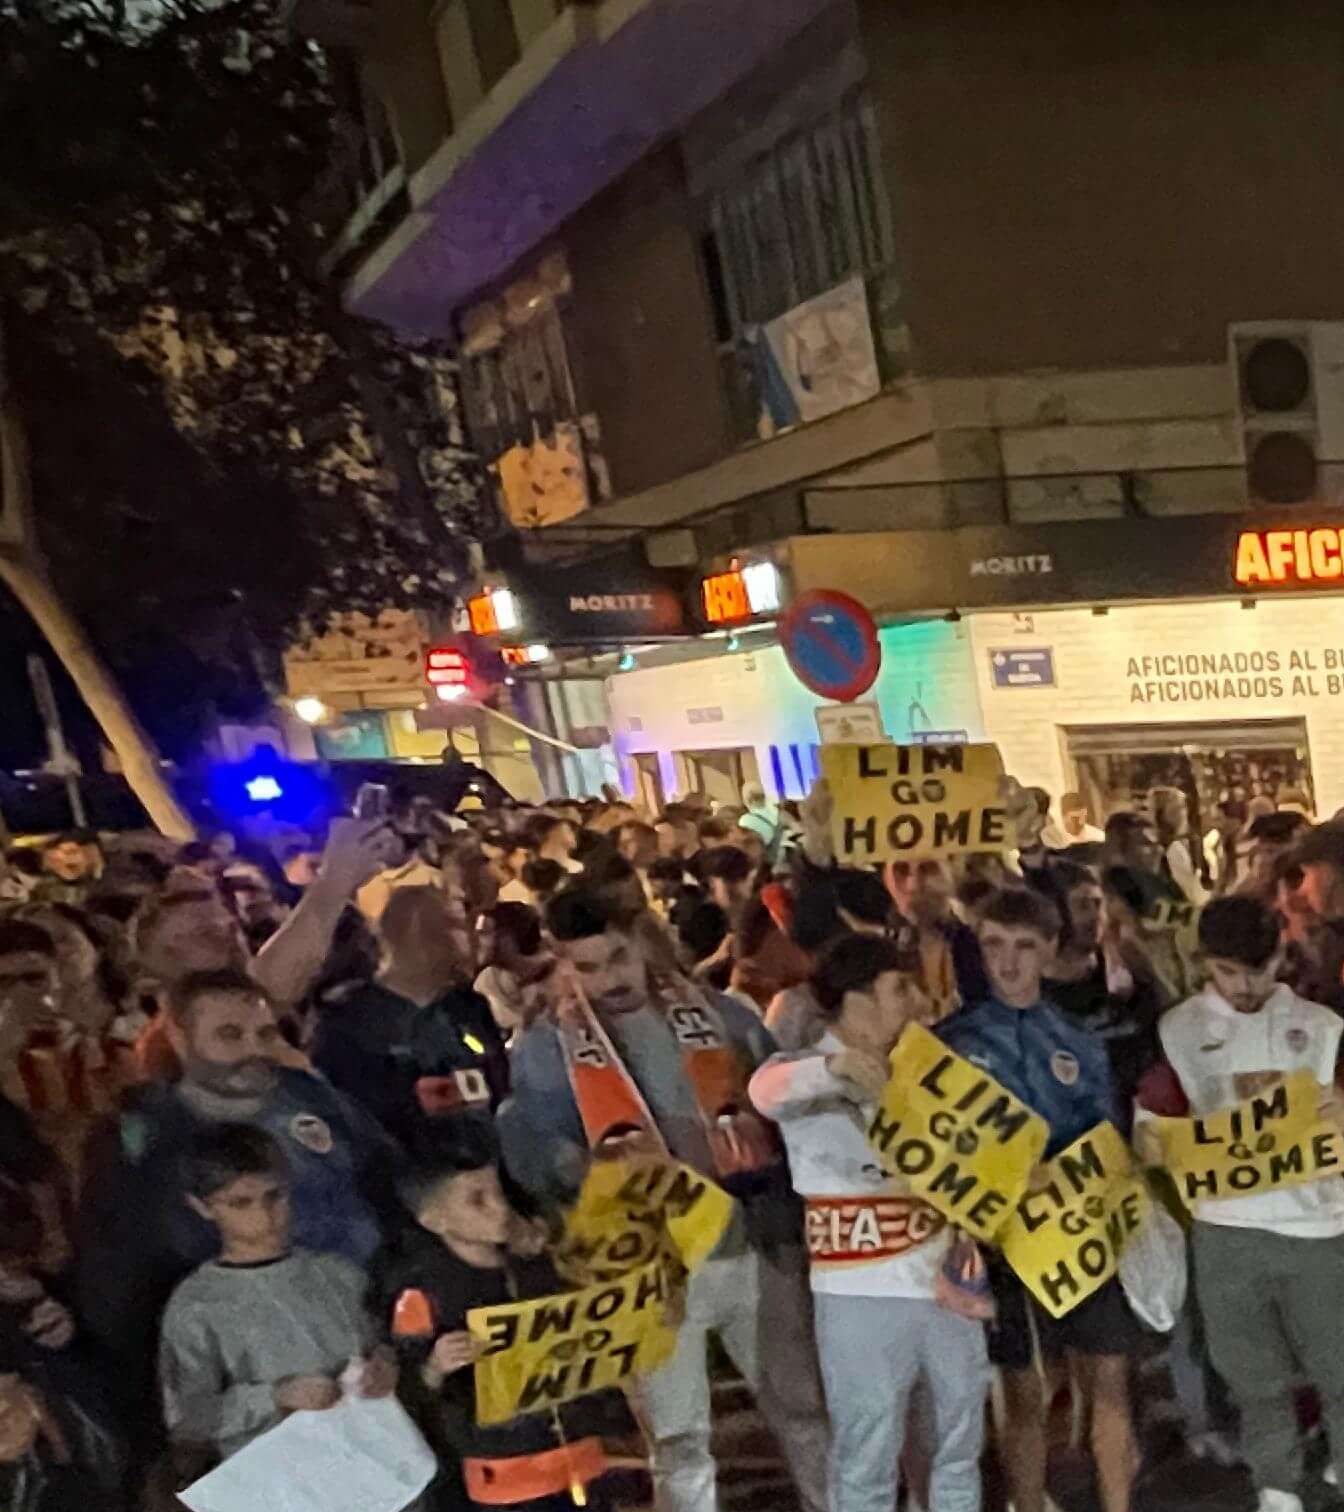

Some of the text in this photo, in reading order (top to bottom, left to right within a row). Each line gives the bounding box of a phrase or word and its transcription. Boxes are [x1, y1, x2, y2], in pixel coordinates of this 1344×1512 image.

[968, 554, 1055, 576] MORITZ
[569, 593, 656, 613] MORITZ
[1126, 650, 1281, 678] AFICIONADOS
[1289, 648, 1318, 672] AL
[1129, 676, 1285, 704] AFICIONADOS
[1291, 673, 1322, 698] AL
[858, 745, 964, 778] LIM
[890, 779, 947, 805] GO
[843, 808, 1008, 854] HOME
[919, 1055, 1031, 1145] LIM
[1193, 1085, 1290, 1145] LIM
[929, 1110, 979, 1156] GO
[868, 1107, 1009, 1229] HOME
[1017, 1140, 1107, 1234] LIM
[1184, 1133, 1339, 1199] HOME
[1060, 1195, 1105, 1235] GO
[1040, 1192, 1142, 1308] HOME
[480, 1268, 664, 1357] HOME
[518, 1342, 641, 1409] LIM
